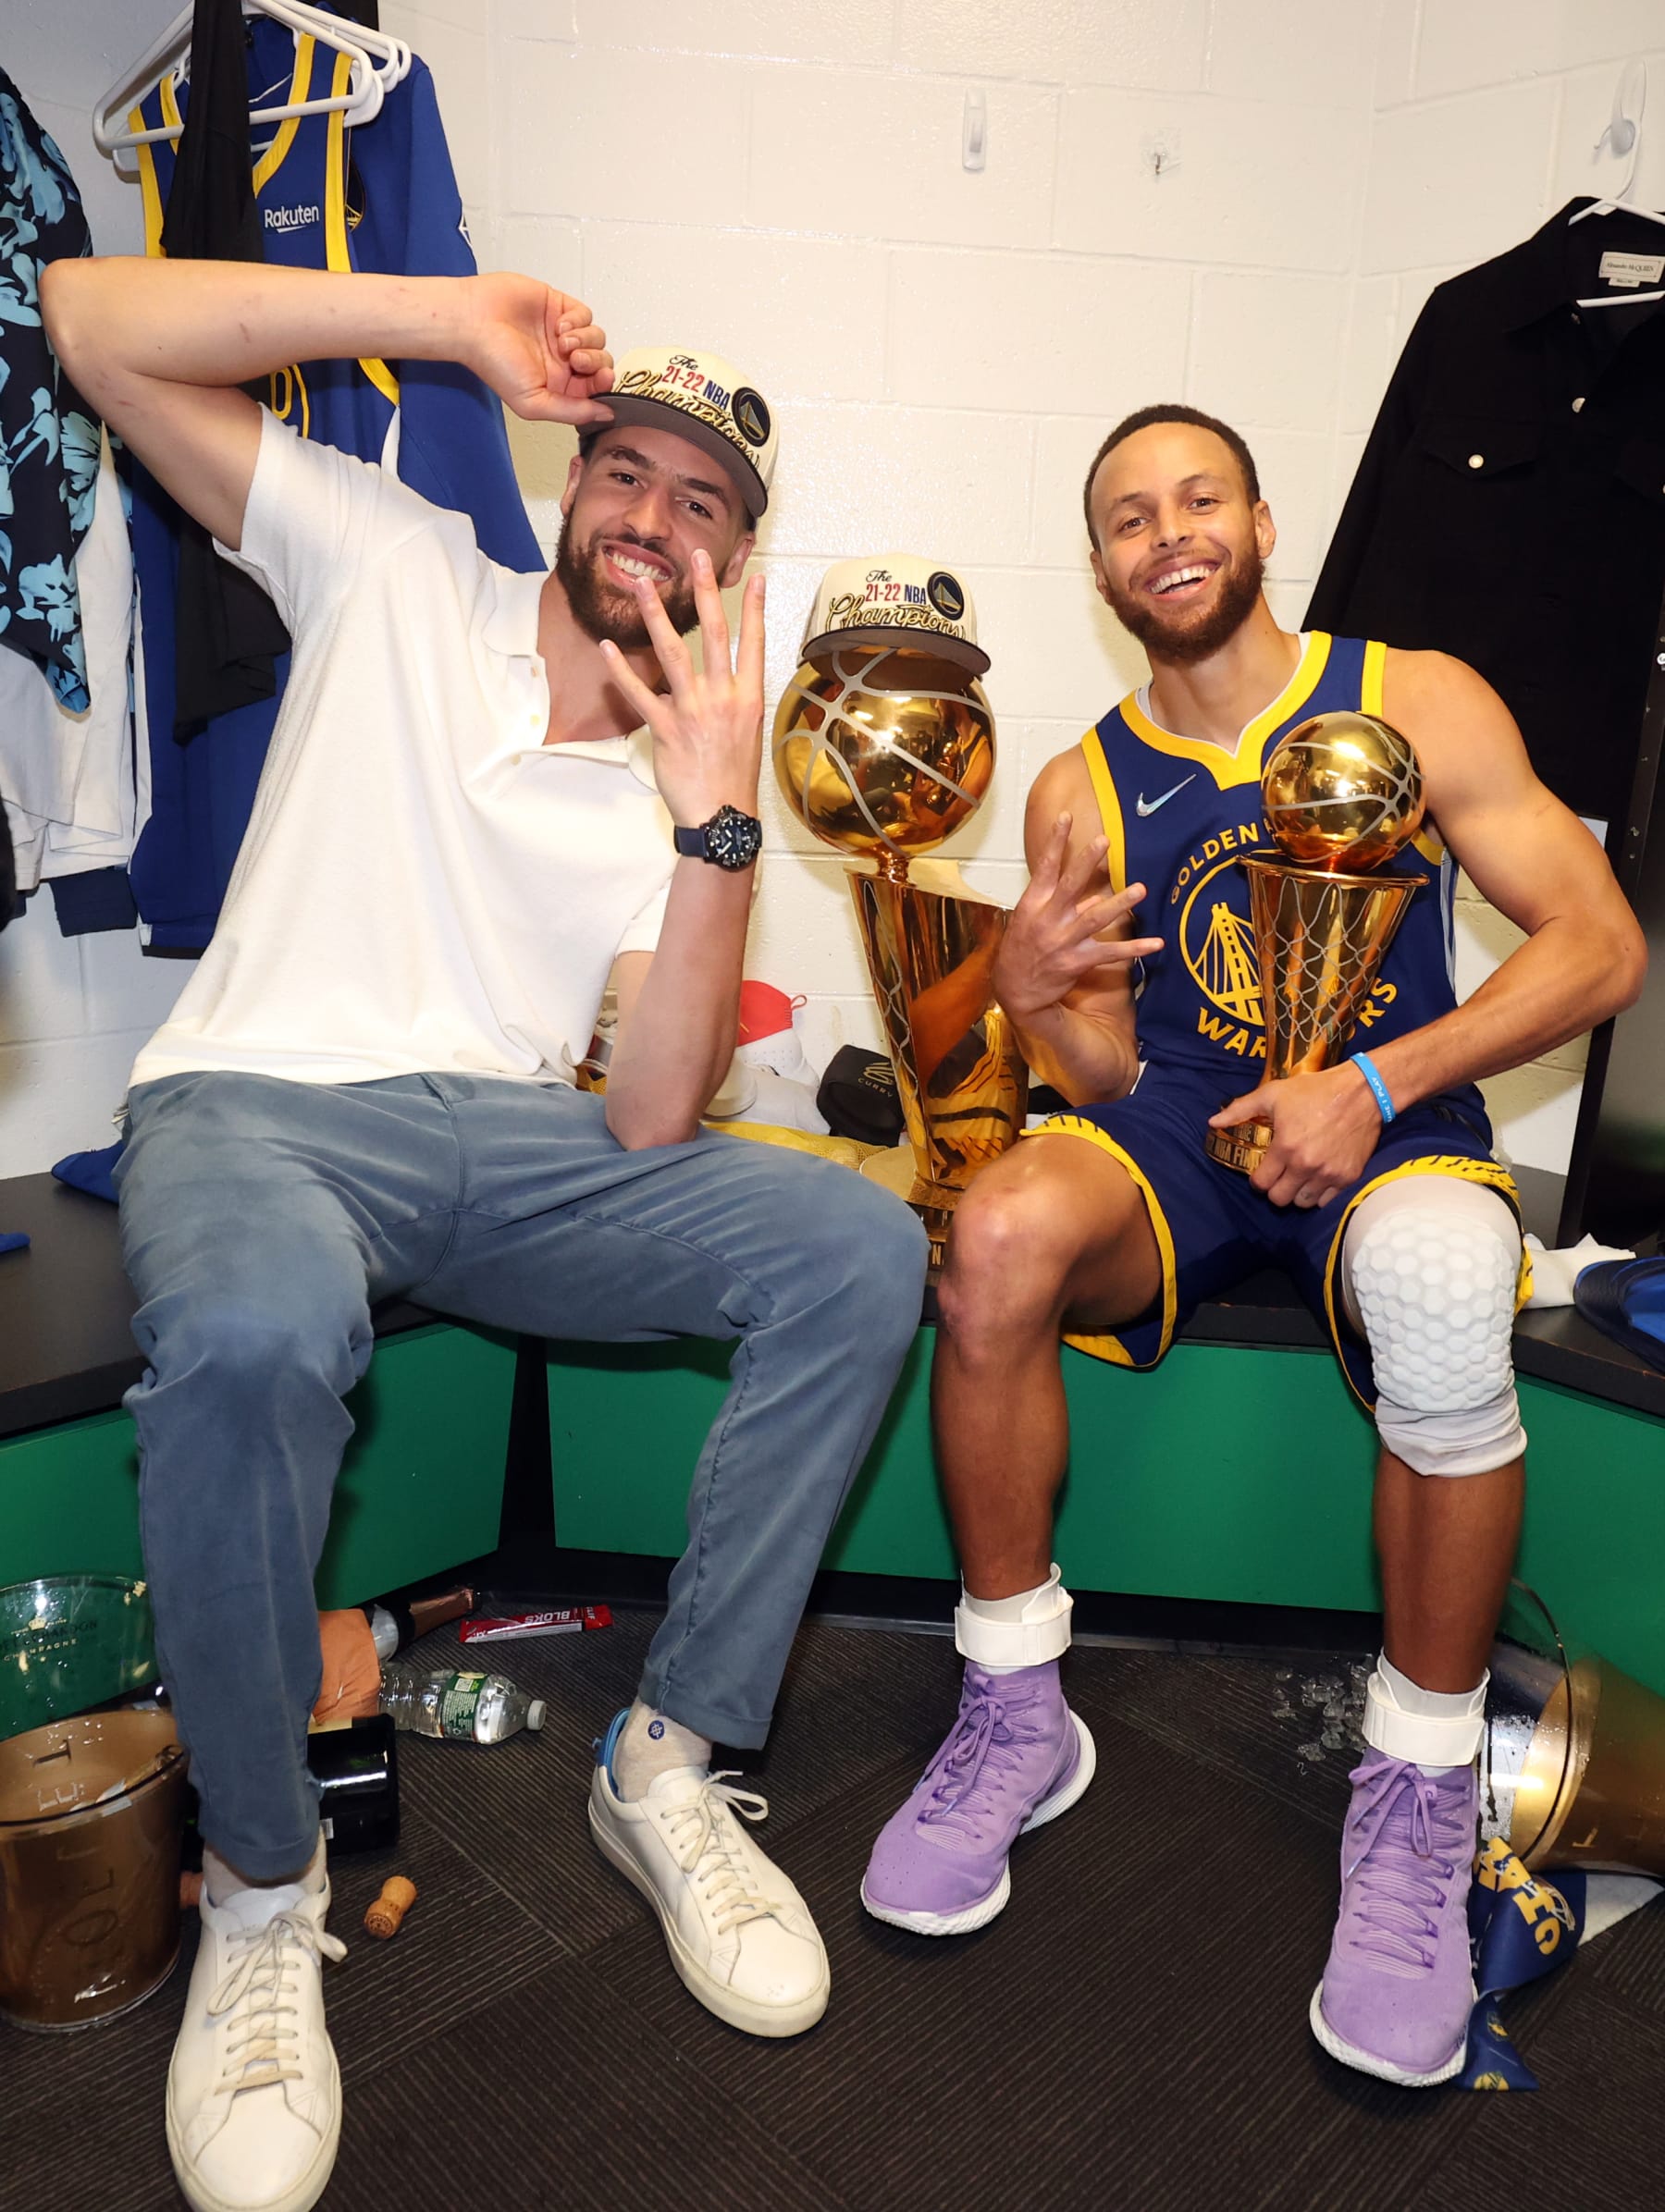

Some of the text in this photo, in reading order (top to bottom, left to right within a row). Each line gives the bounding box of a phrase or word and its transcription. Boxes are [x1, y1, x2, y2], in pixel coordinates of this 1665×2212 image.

[264, 204, 320, 228] Rakuten
[669, 354, 699, 371] The
[661, 365, 731, 411] 21-22 NBA
[866, 570, 893, 583] The
[865, 584, 927, 605] 21-22 NBA
[825, 593, 967, 639] Champions
[1170, 822, 1260, 905] GOLDEN
[1372, 1077, 1385, 1097] PLAY
[524, 1610, 571, 1625] BLOKS
